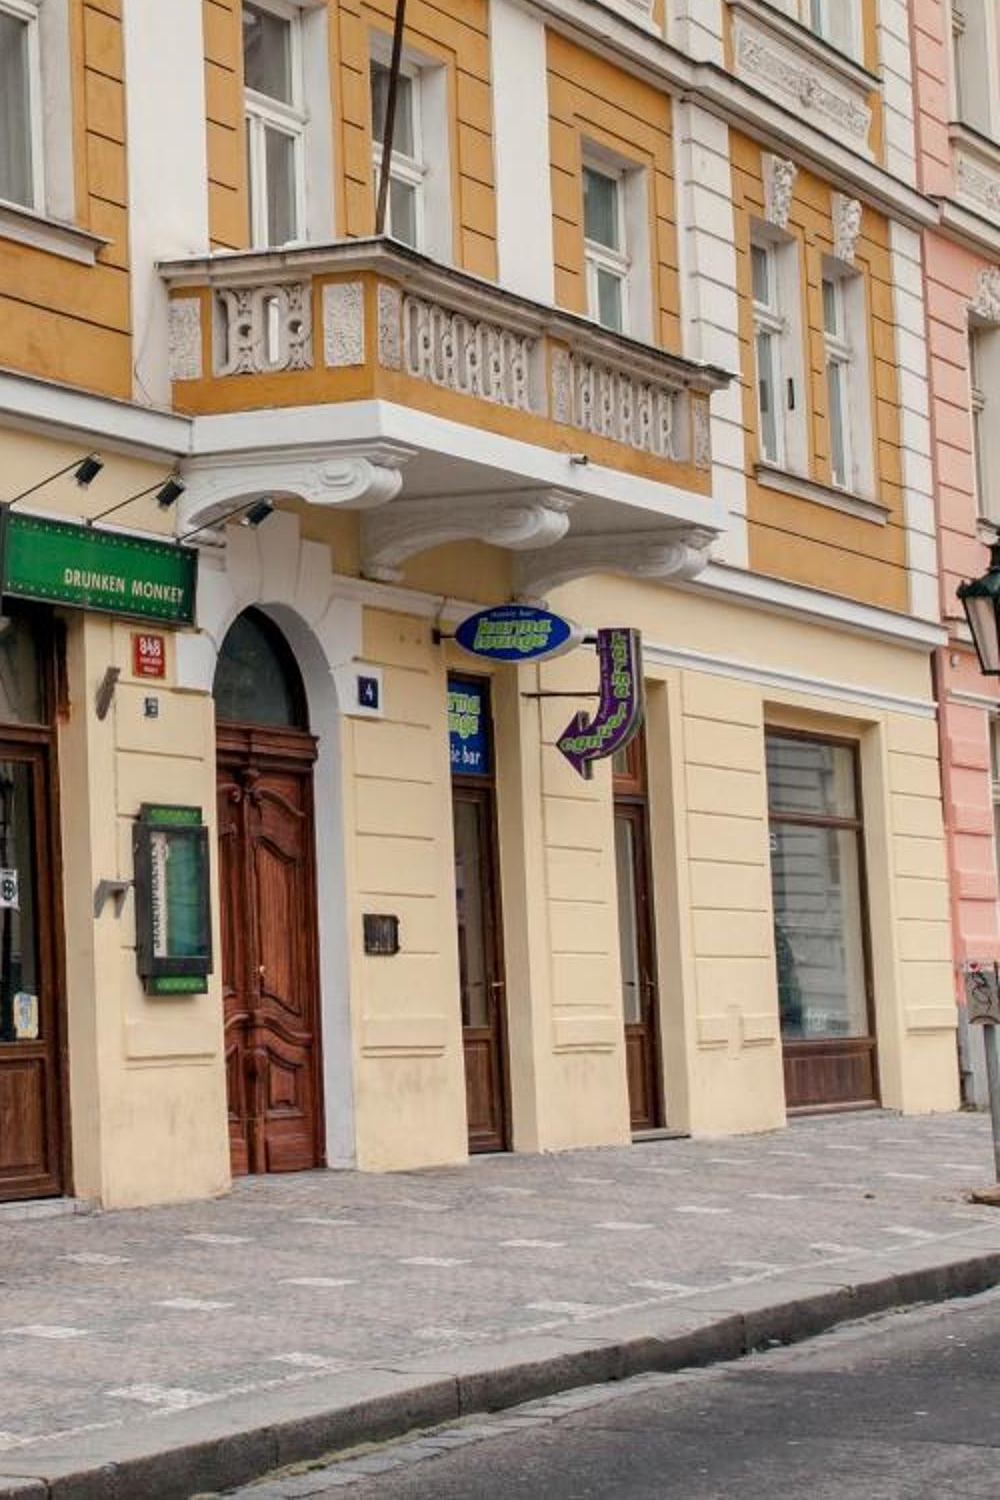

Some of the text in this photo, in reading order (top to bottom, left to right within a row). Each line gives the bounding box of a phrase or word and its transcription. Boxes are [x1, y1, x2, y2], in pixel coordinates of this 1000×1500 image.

[64, 567, 184, 603] DRUNKEN MONKEY
[365, 683, 373, 701] 4
